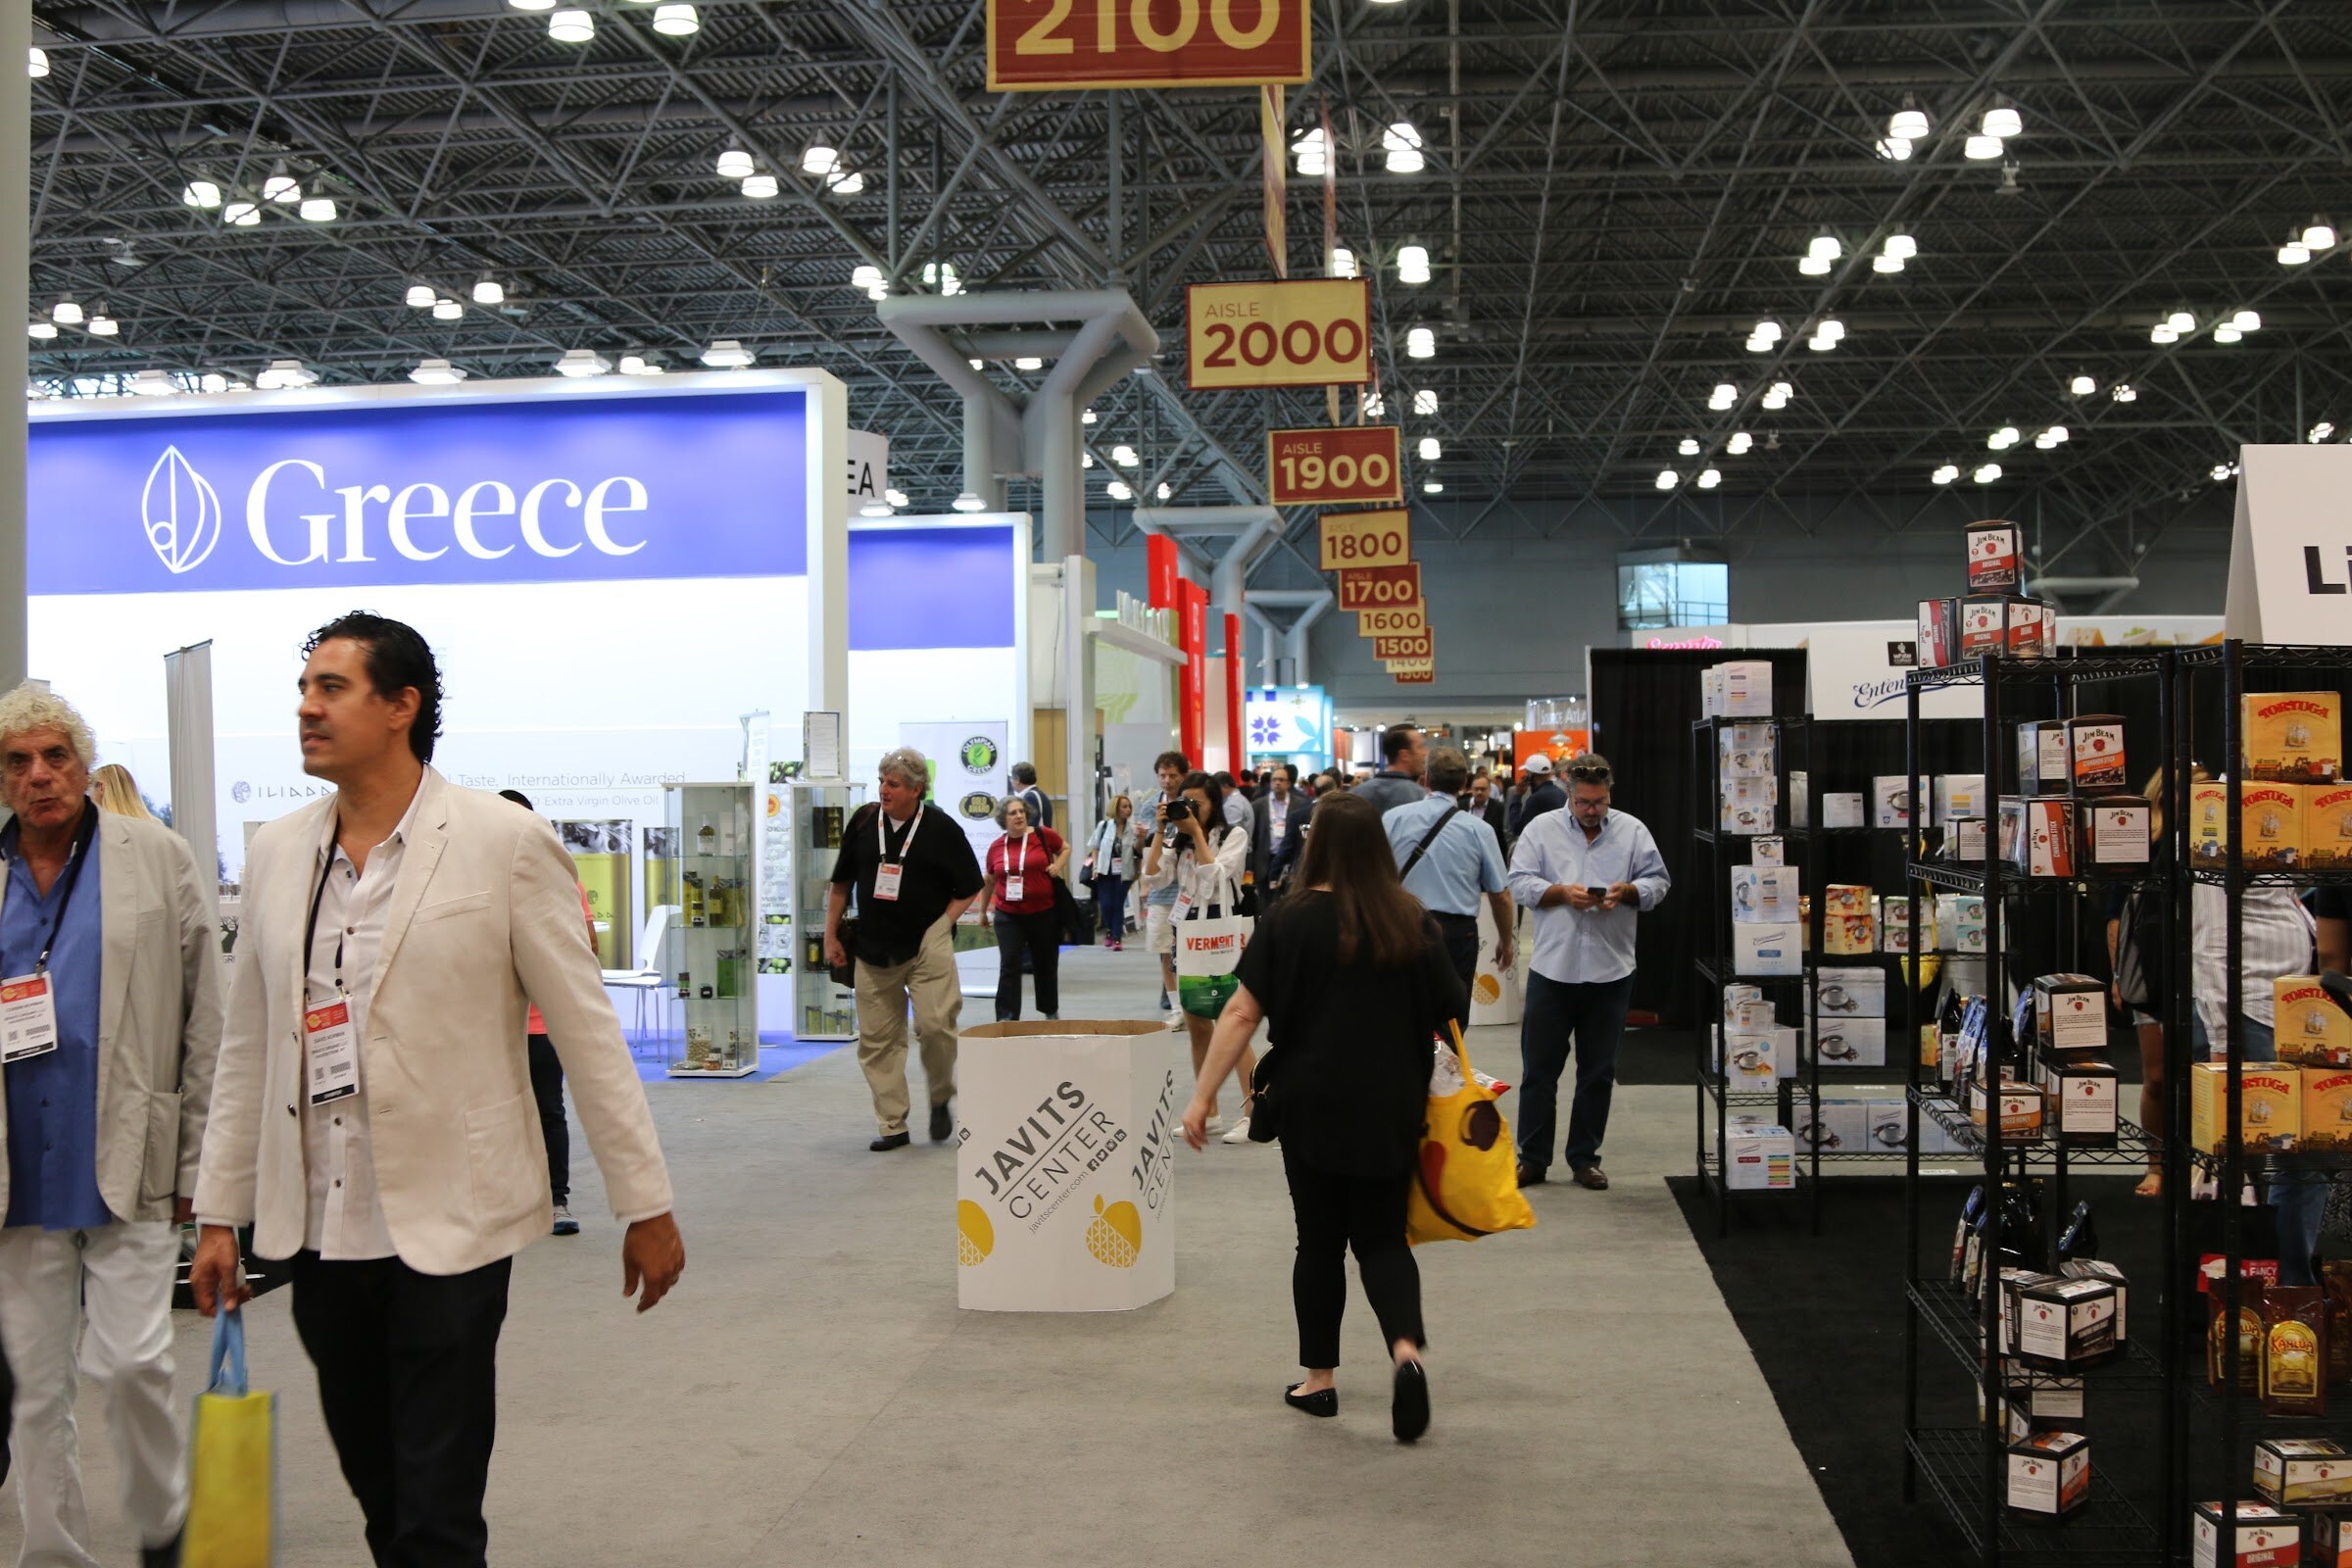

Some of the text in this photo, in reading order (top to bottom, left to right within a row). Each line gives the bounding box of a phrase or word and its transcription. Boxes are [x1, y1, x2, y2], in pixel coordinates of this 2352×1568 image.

[1015, 0, 1281, 55] 2100
[1204, 302, 1260, 318] AISLE
[1203, 318, 1363, 368] 2000
[1282, 443, 1322, 455] AISLE
[1280, 454, 1391, 490] 1900
[246, 459, 648, 565] Greece
[1328, 523, 1356, 533] AISLE
[1327, 531, 1401, 560] 1800
[1348, 571, 1372, 580] AISLE
[1346, 580, 1413, 603] 1700
[1364, 612, 1420, 629] 1600
[1378, 638, 1428, 655] 1500
[2258, 700, 2328, 719] TORTUGA
[2095, 728, 2115, 741] BEAM
[963, 737, 996, 753] OLYMPIAN
[458, 774, 499, 787] Taste,
[508, 772, 615, 789] Internationally
[620, 771, 685, 785] Awarded
[544, 796, 573, 807] Extra
[577, 795, 607, 808] Virgin
[612, 795, 640, 806] Olive
[644, 795, 659, 806] Oil
[2195, 789, 2226, 803] TORTUGA
[1186, 934, 1234, 951] VERMONT
[974, 1081, 1086, 1196] JAVITS
[1009, 1110, 1115, 1219] CENTER
[1028, 1171, 1088, 1235] javitscenter.com
[2249, 1266, 2277, 1276] FANCY
[2247, 1551, 2275, 1564] ORIGINAL
